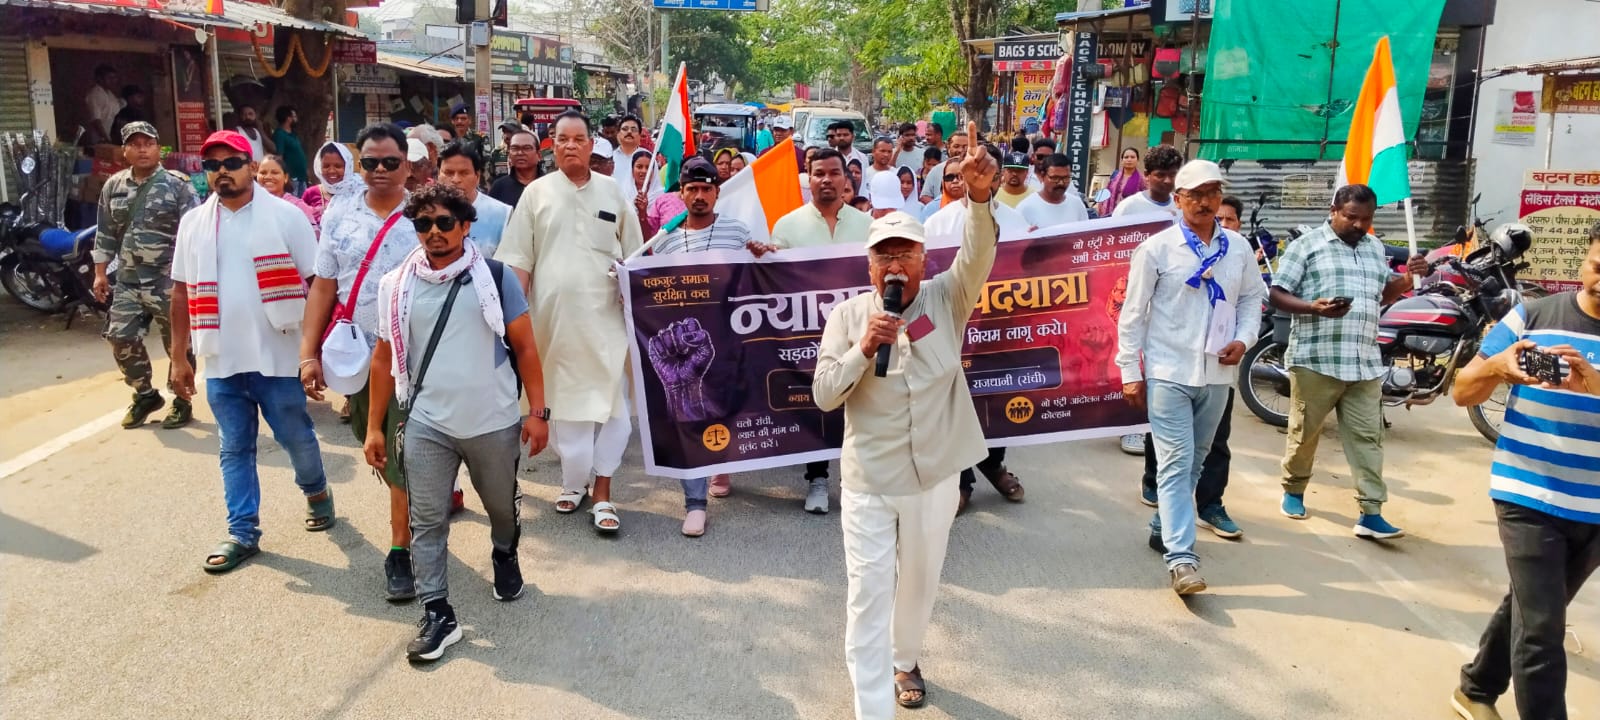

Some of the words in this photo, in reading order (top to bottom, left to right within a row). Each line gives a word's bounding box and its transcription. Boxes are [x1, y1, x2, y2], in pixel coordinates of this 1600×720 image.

[998, 45, 1026, 58] BAGS
[1027, 45, 1036, 57] &
[1079, 33, 1091, 63] BAGS
[1074, 74, 1087, 122] CHOOL
[1533, 172, 1572, 184] बटन
[1574, 172, 1600, 186] हाउ
[1073, 239, 1084, 250] नो
[1087, 236, 1103, 249] एंट्री
[1106, 234, 1116, 246] से
[1072, 251, 1089, 264] सभी
[1092, 250, 1111, 262] केस
[643, 274, 677, 288] एकजुट
[680, 273, 710, 285] समाज
[652, 289, 687, 305] सुरक्षित
[690, 287, 710, 300] कल
[778, 341, 820, 364] सड़कों
[968, 327, 1001, 346] नियम
[1006, 325, 1035, 344] लागू
[788, 394, 810, 402] न्याय
[972, 374, 1014, 389] राजधानी
[1017, 371, 1046, 387] (रांची)
[1040, 397, 1050, 408] नो
[1053, 395, 1068, 408] एंट्री
[1070, 393, 1100, 405] आंदोलन
[1040, 410, 1071, 420] कोल्हान
[736, 418, 752, 428] चलो
[738, 430, 756, 440] न्याय
[758, 427, 769, 437] की
[771, 426, 787, 435] मांग
[789, 423, 800, 433] को
[738, 442, 758, 454] बुलंद
